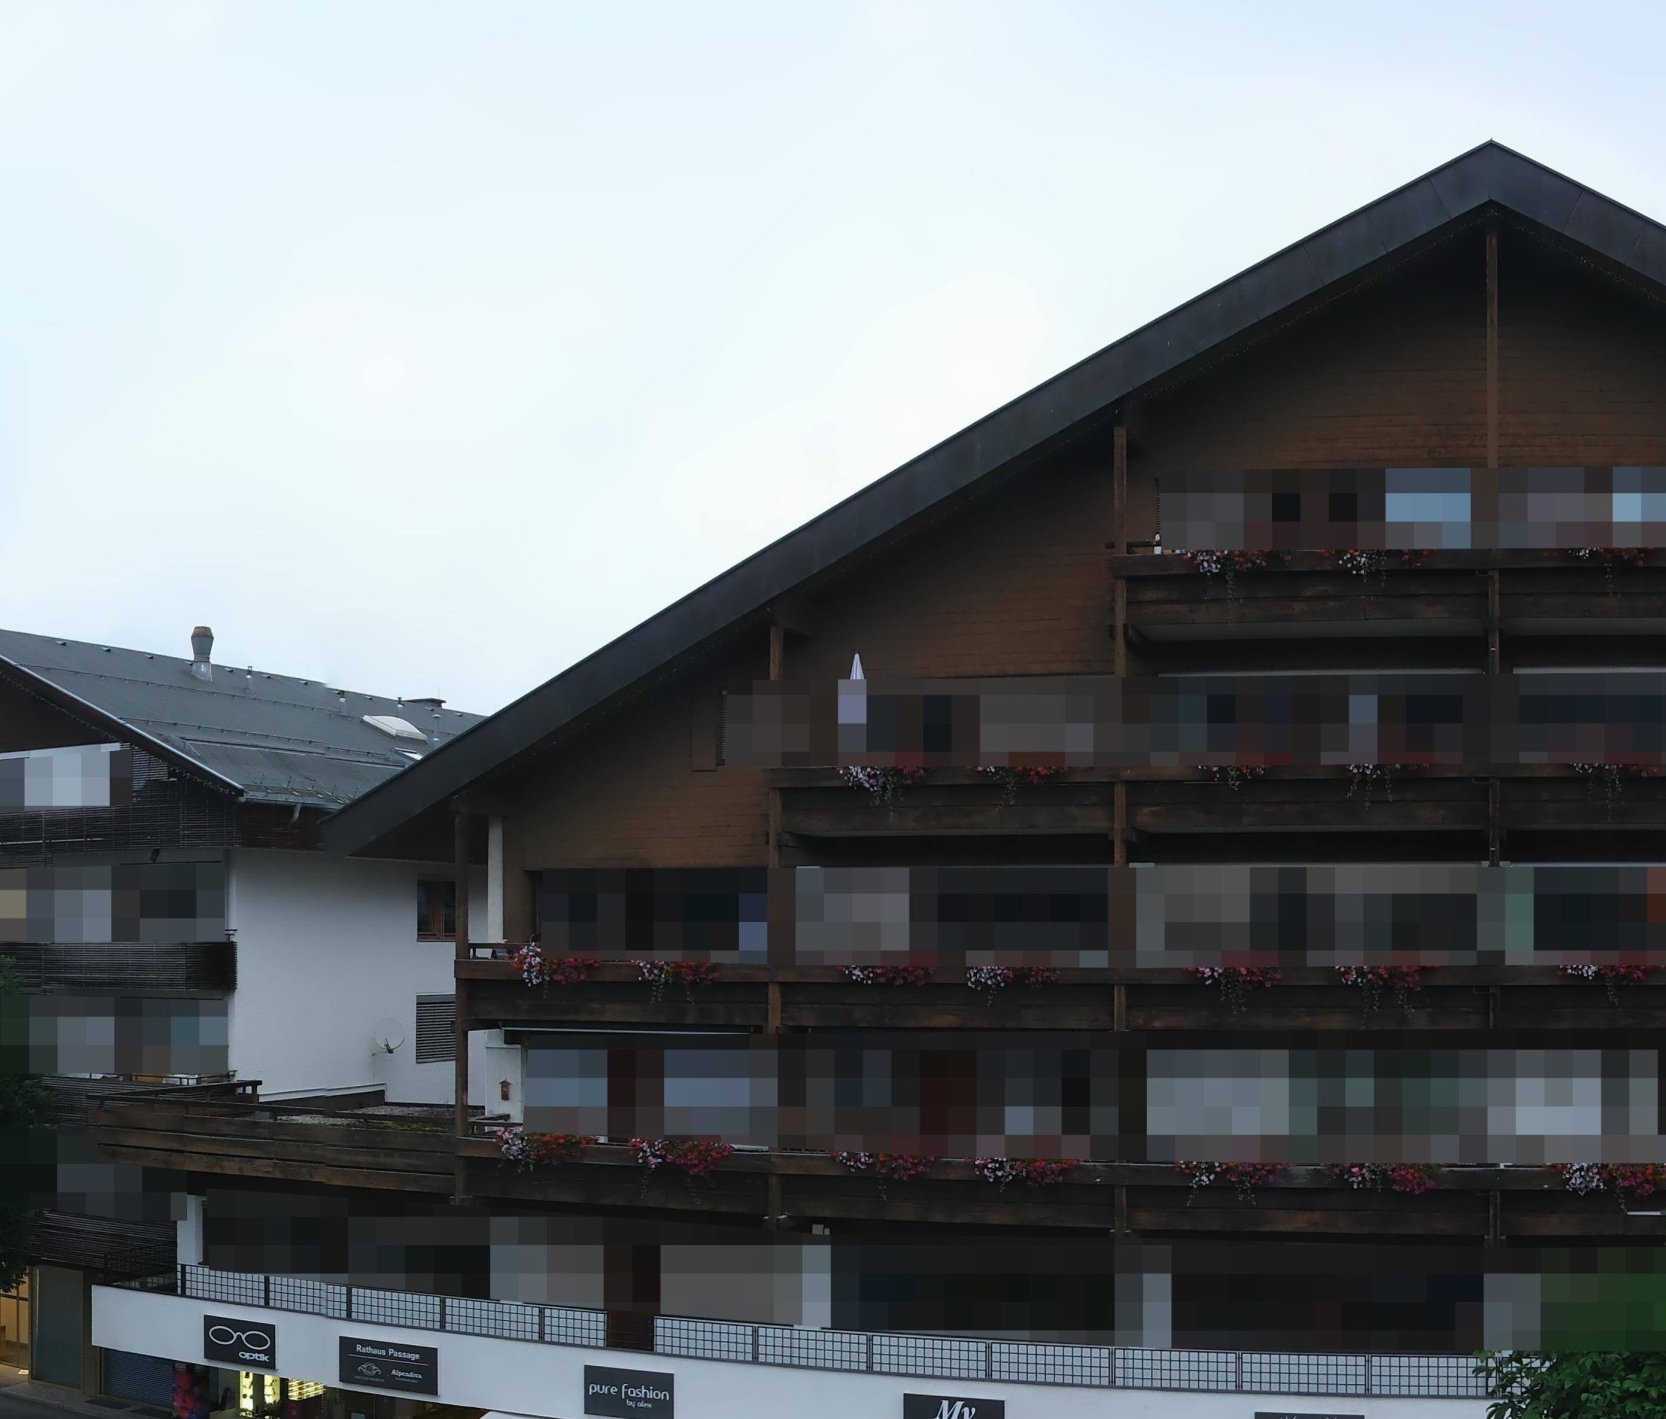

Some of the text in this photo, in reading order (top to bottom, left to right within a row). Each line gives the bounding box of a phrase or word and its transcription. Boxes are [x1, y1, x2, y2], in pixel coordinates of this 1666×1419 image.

[239, 1351, 270, 1362] optik
[356, 1344, 420, 1361] Rathaus Passage
[589, 1383, 669, 1401] pure fashion
[626, 1400, 653, 1409] by alex
